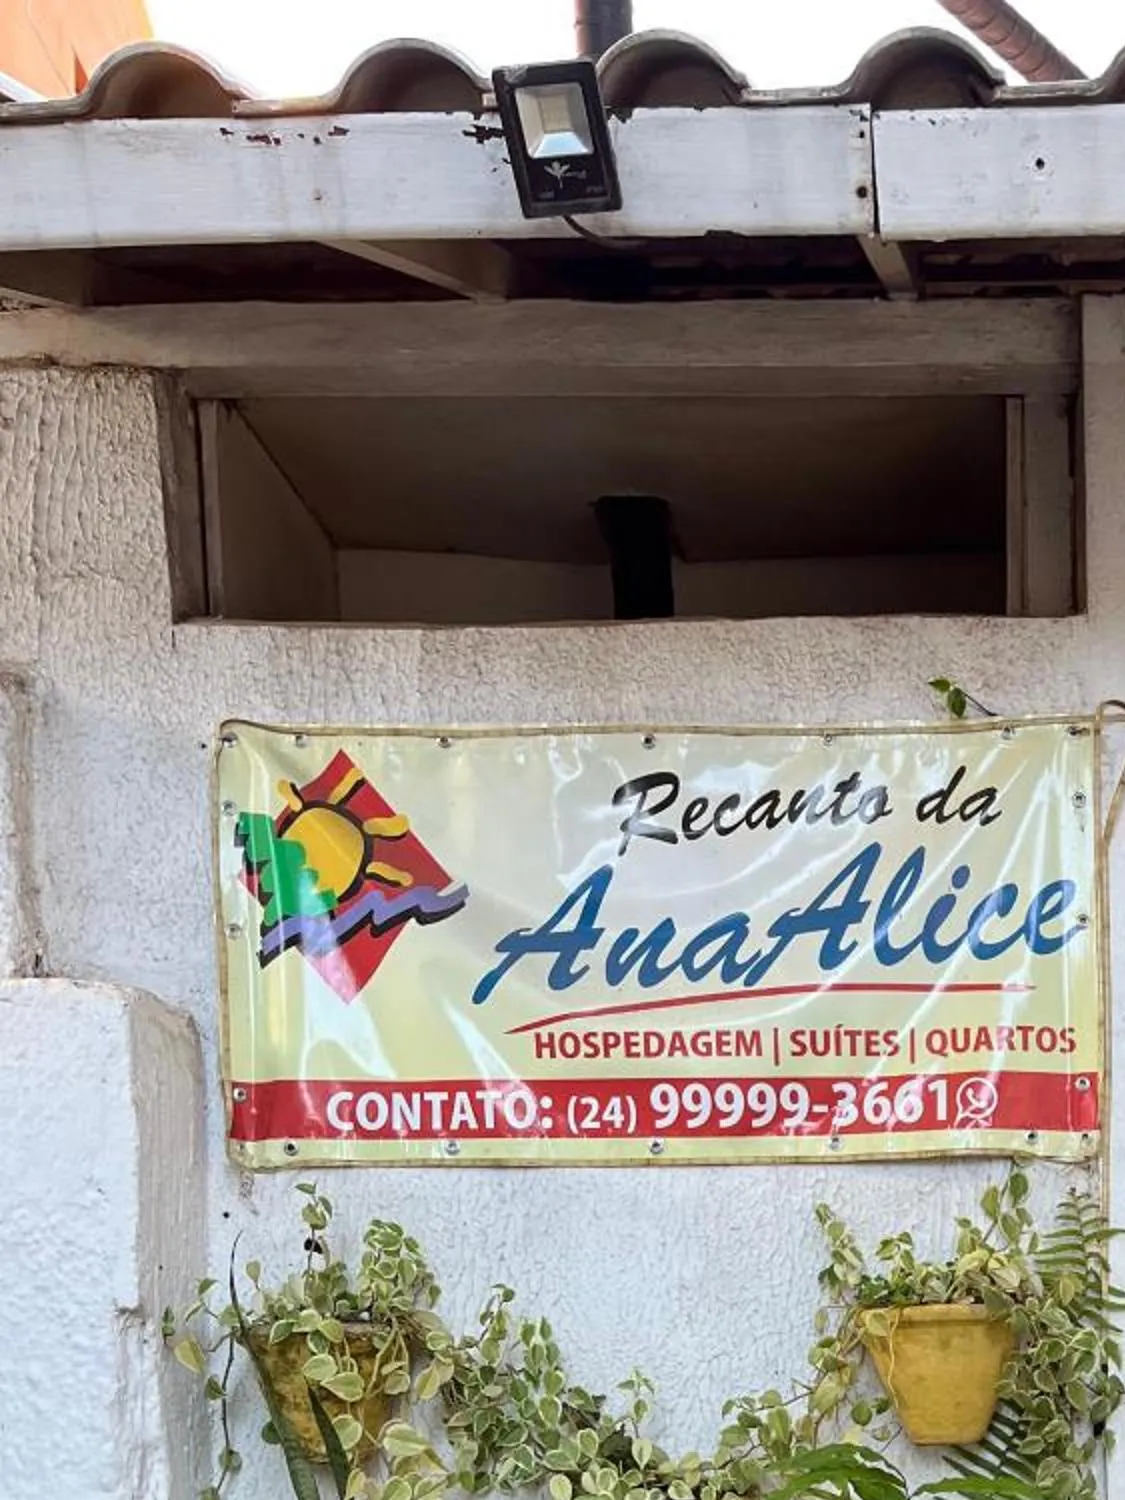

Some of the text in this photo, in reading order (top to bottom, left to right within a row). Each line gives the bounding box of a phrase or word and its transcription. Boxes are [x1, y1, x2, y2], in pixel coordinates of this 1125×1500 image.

[612, 765, 1003, 857] Recanto da
[471, 840, 1090, 1006] AnaAlice
[534, 1024, 1077, 1060] HOSPEDAGEM SUÍTES QUARTOS
[326, 1077, 951, 1133] CONTATO: (24) 99999-3661
